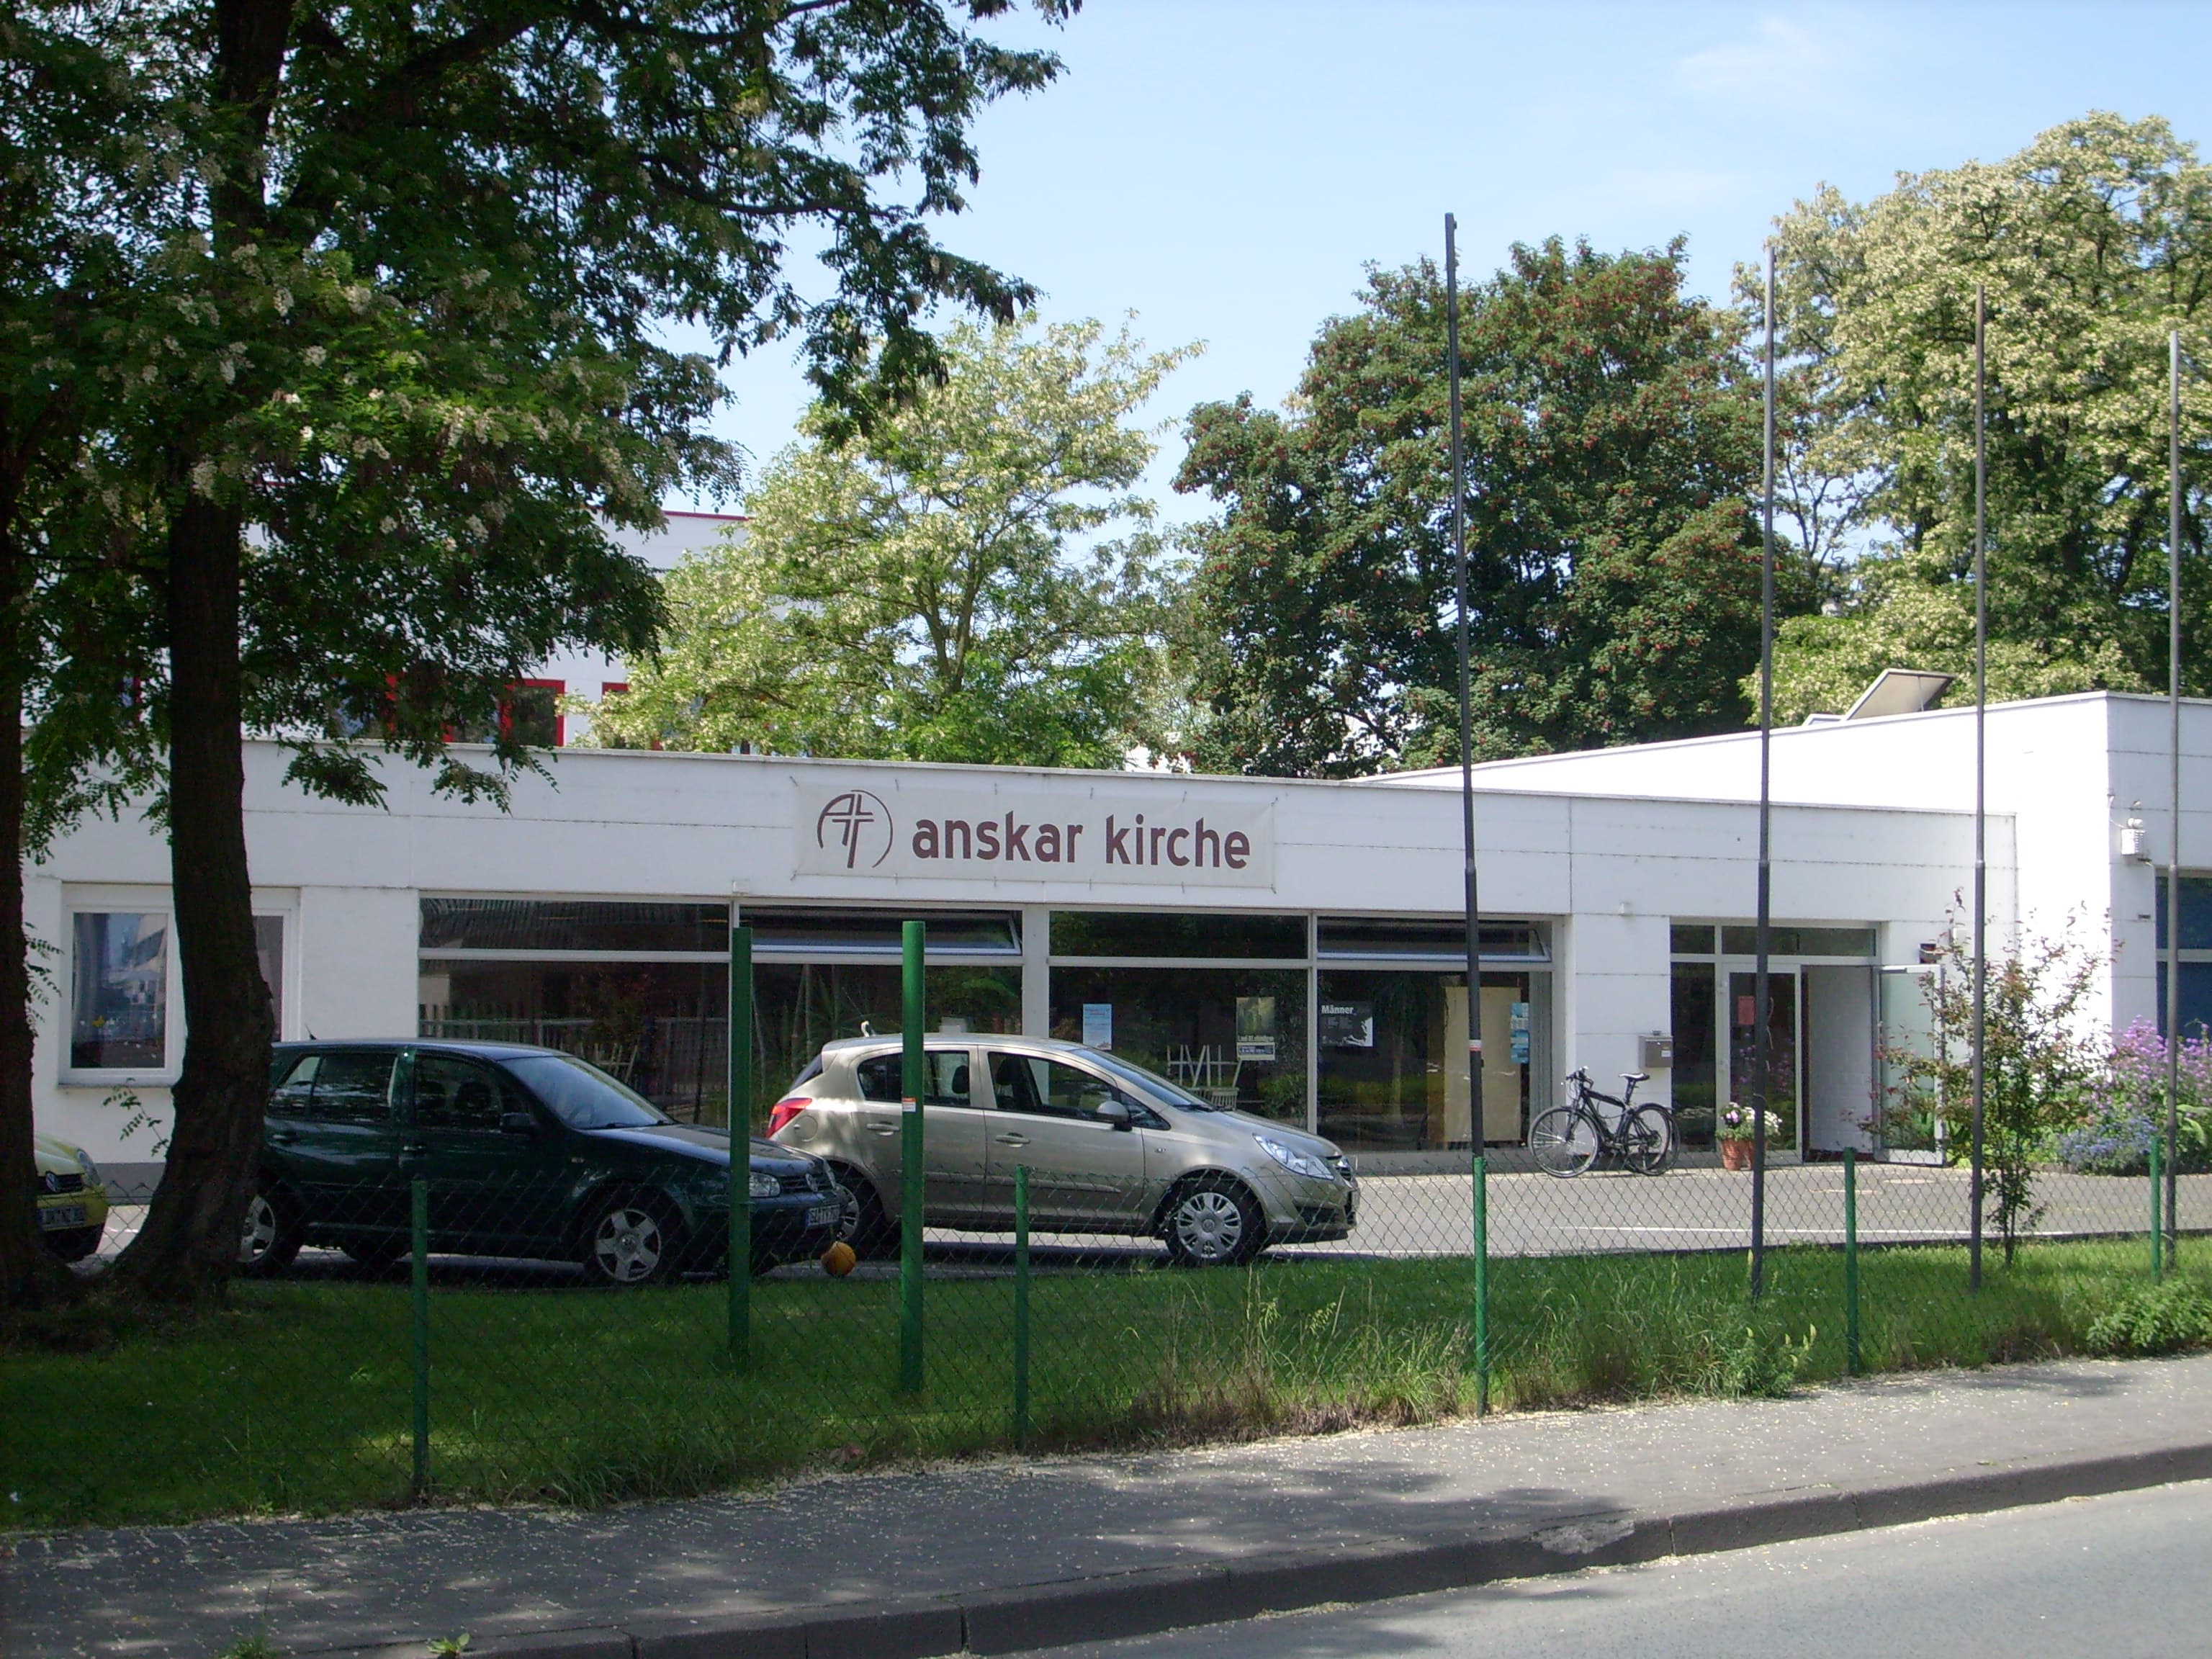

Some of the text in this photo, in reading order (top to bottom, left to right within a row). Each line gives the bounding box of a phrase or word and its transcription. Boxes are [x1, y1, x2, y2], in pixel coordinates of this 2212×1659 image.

[912, 811, 1250, 869] anskar kirche
[1321, 1004, 1354, 1015] Männer
